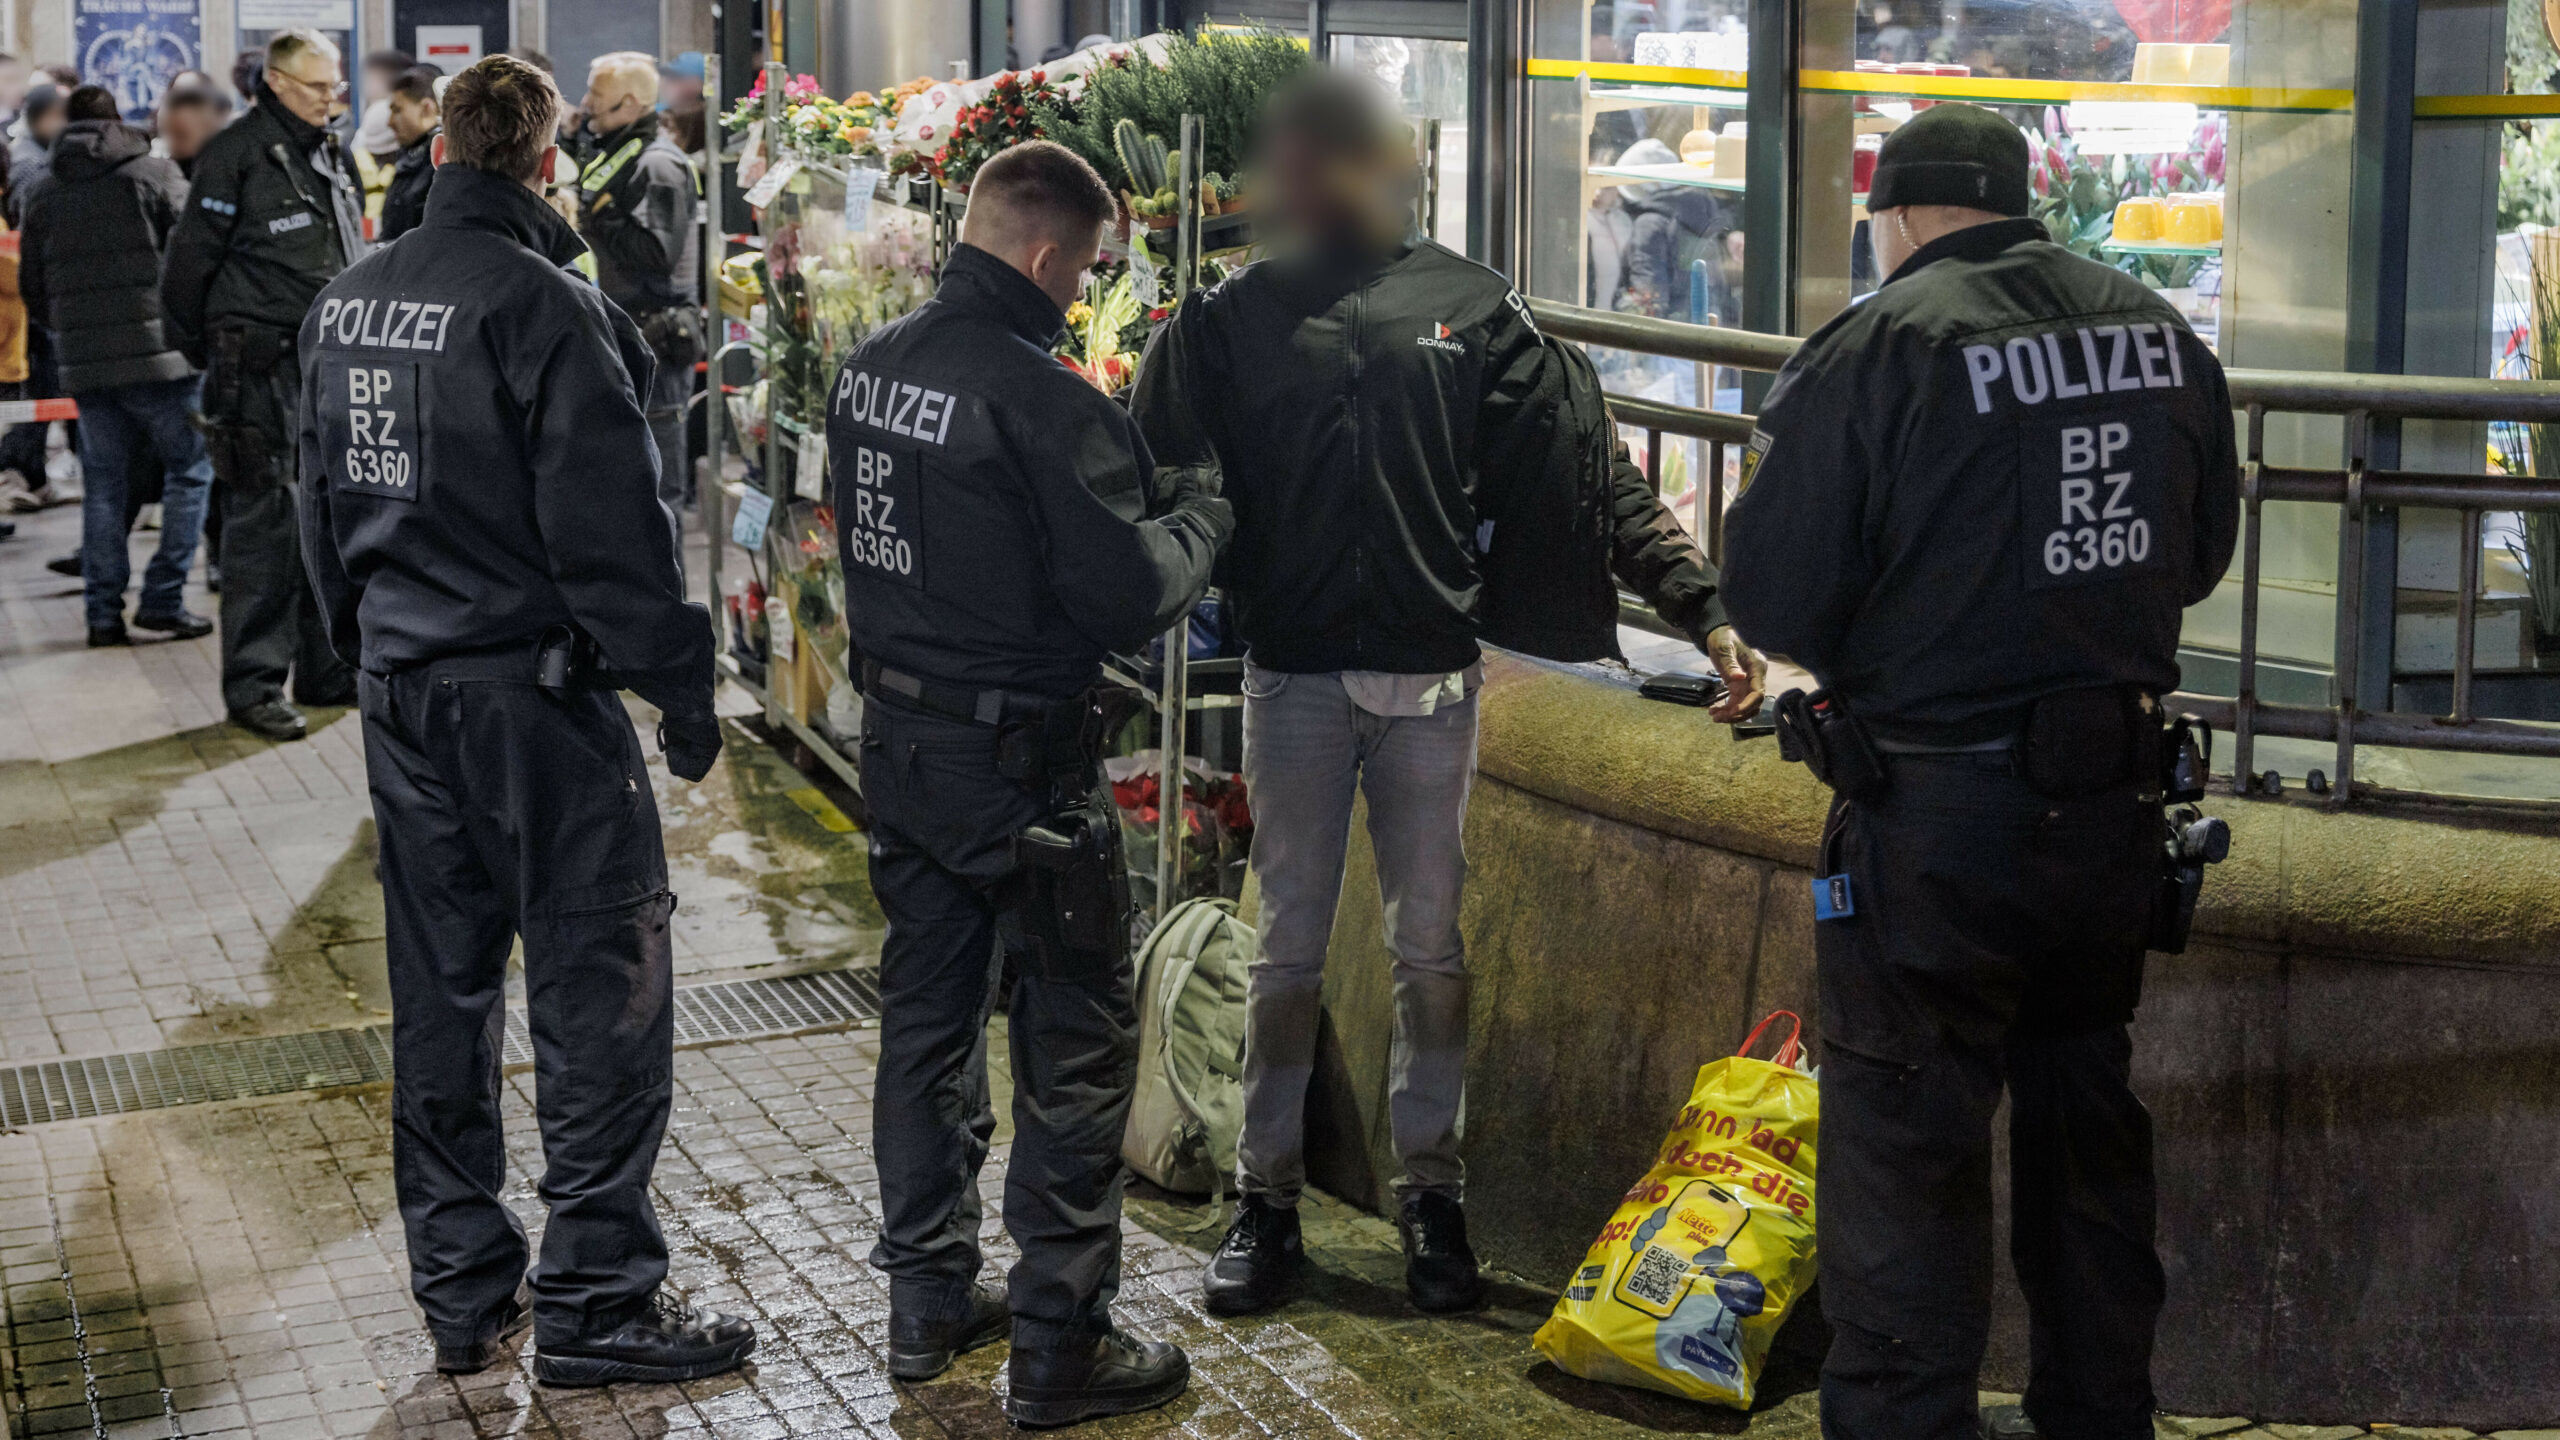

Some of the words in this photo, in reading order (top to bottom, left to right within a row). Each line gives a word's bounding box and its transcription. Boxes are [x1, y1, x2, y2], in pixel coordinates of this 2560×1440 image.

[269, 212, 312, 234] POLIZEI
[319, 298, 455, 351] POLIZEI
[1417, 337, 1463, 352] DONNAY
[349, 368, 392, 404] BP
[1962, 322, 2183, 414] POLIZEI
[349, 409, 399, 446] RZ
[835, 368, 956, 445] POLIZEI
[346, 448, 410, 487] 6360
[857, 446, 893, 488] BP
[2061, 422, 2129, 473] BP
[856, 488, 897, 533] RZ
[2060, 472, 2132, 525] RZ
[851, 527, 912, 575] 6360
[2044, 518, 2149, 575] 6360
[1742, 1117, 1802, 1166] lad
[1667, 1139, 1743, 1177] doch
[1752, 1171, 1810, 1217] die
[1676, 1207, 1718, 1237] Netto
[1687, 1230, 1709, 1247] plus
